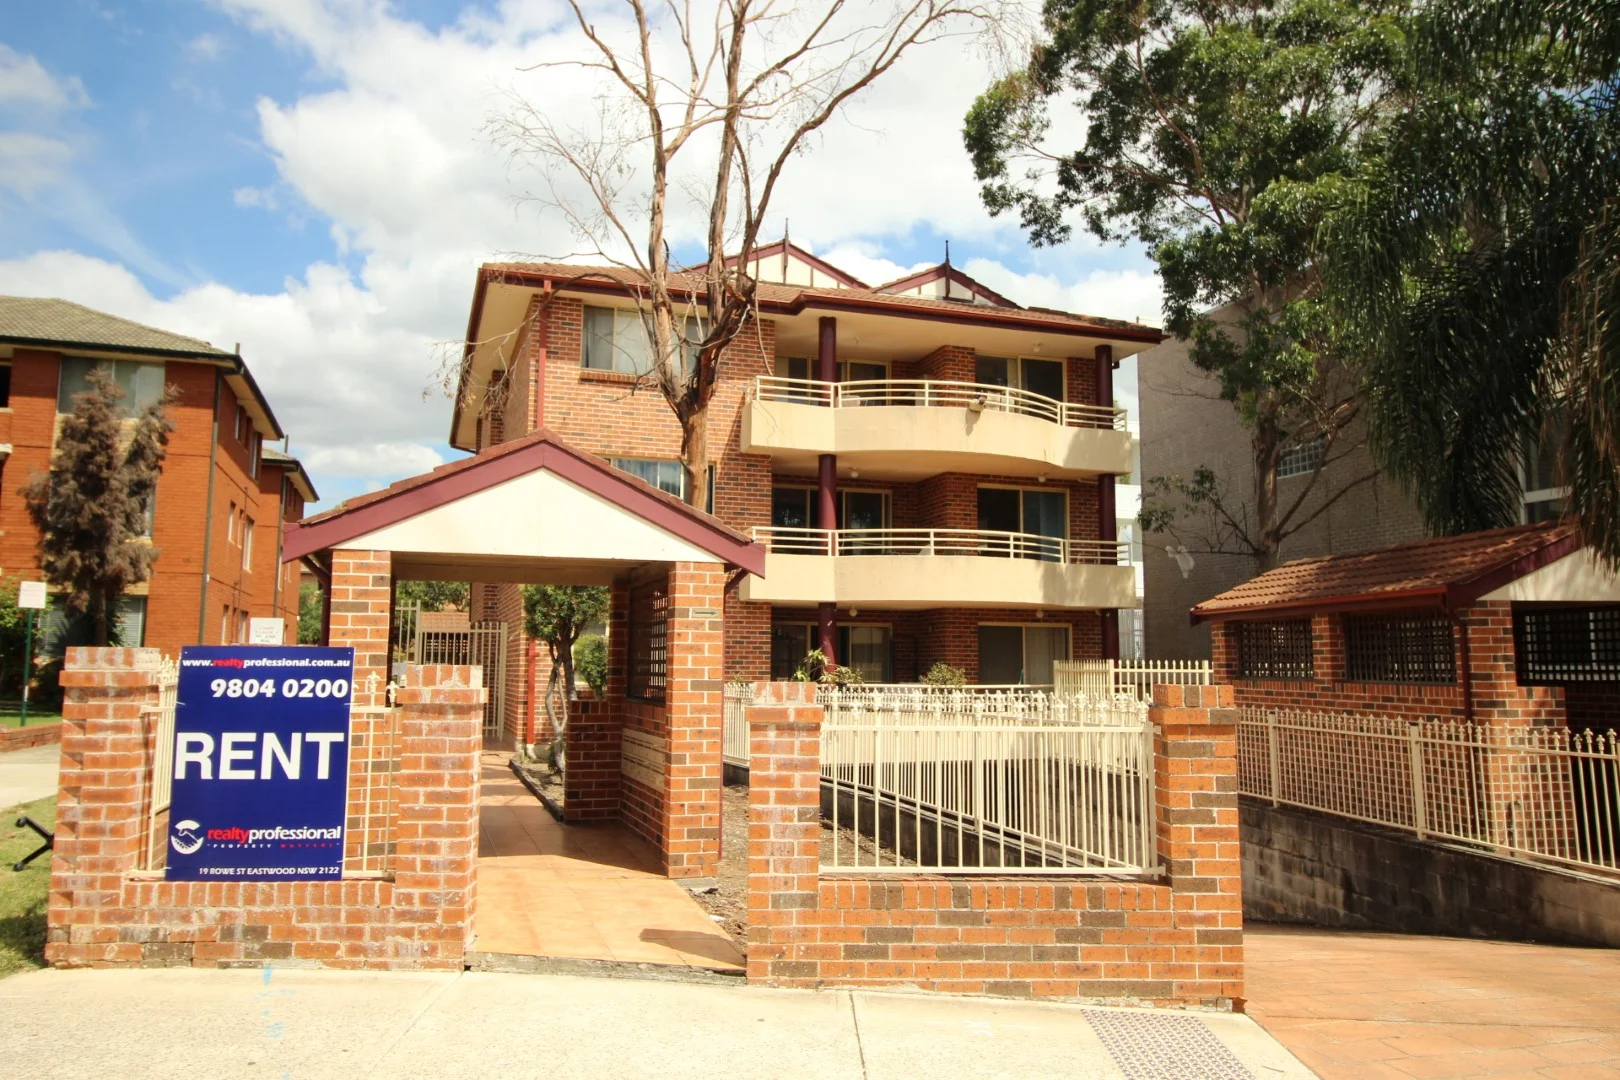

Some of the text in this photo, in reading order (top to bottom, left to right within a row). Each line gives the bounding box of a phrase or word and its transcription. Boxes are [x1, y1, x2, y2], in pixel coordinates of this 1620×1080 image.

[182, 658, 350, 668] www.realtyprofessional.com.au
[210, 679, 349, 698] 9804 0200
[174, 732, 345, 780] RENT
[207, 825, 341, 844] realtyprofessional
[199, 866, 339, 875] 19 ROWE ST EASTWOOD NSW 2122
